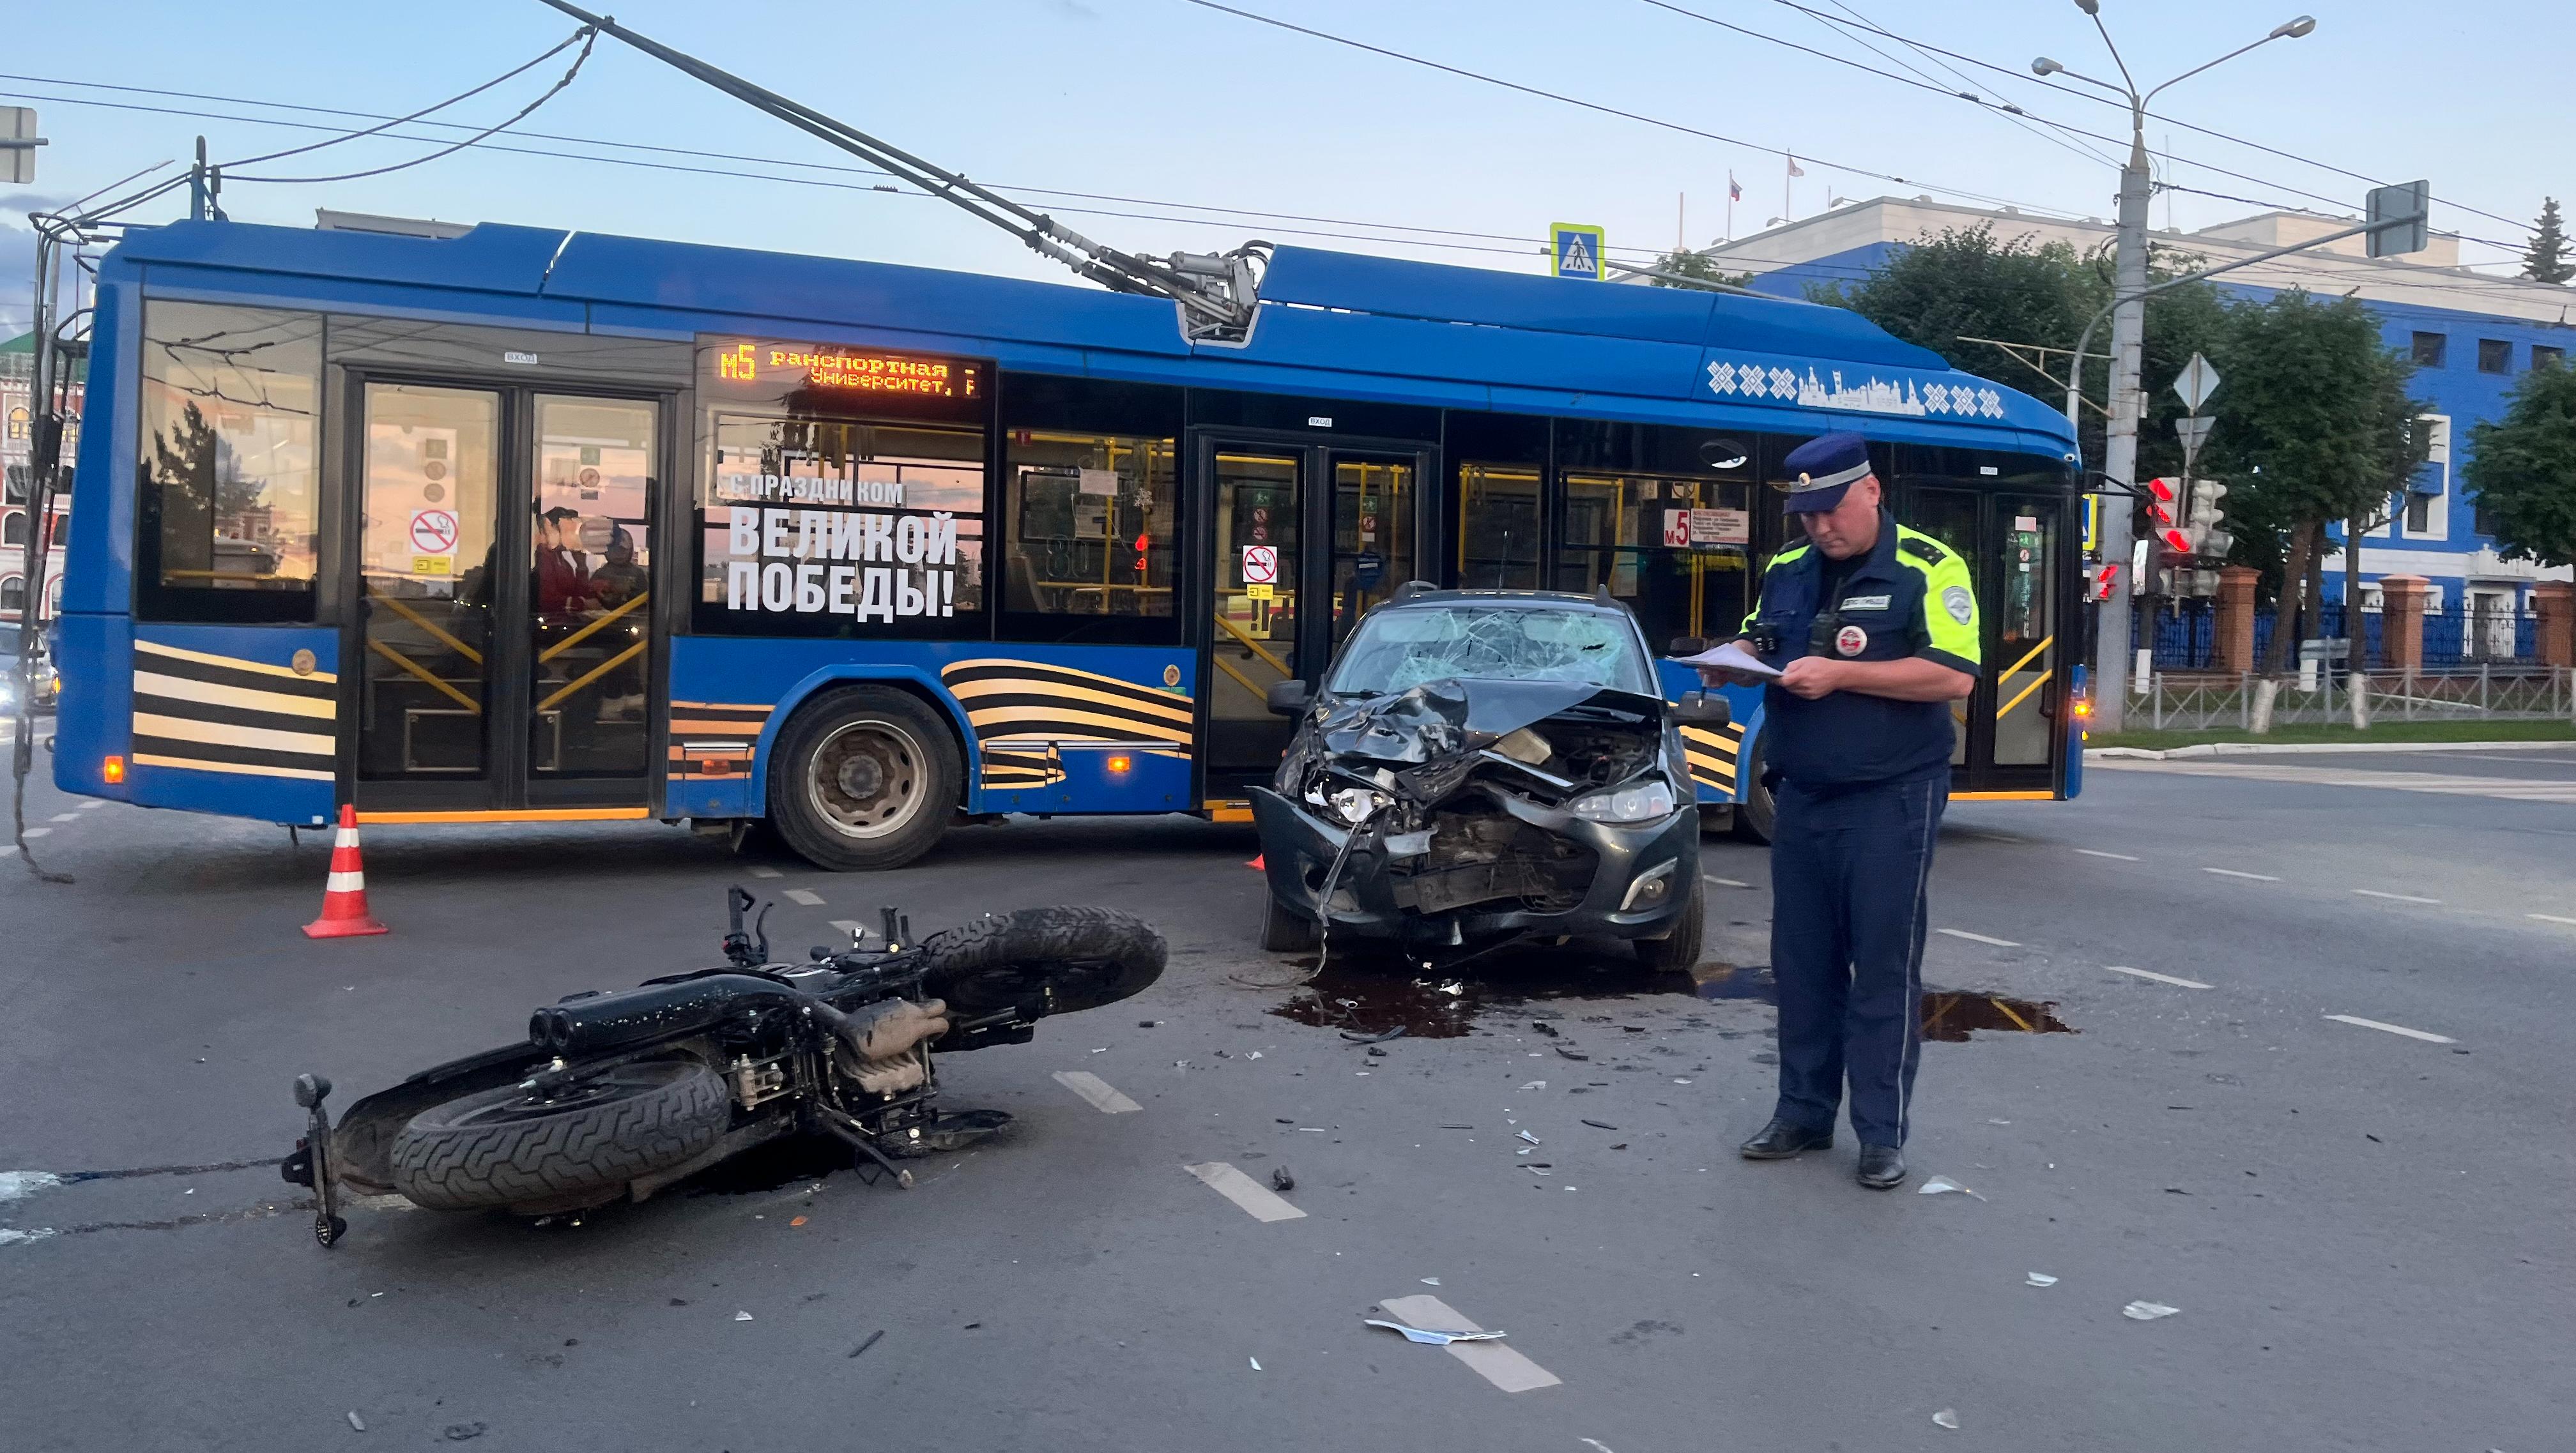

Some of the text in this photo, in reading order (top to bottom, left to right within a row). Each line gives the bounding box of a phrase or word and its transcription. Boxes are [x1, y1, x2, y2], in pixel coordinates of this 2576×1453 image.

[507, 353, 535, 362] ВХОД
[721, 344, 756, 380] М5
[810, 367, 952, 397] Университет,
[730, 475, 903, 504] С ПРАЗДНИКОМ
[729, 506, 956, 565] ВЕЛИКОЙ
[728, 561, 954, 623] ПОБЕДЫ!
